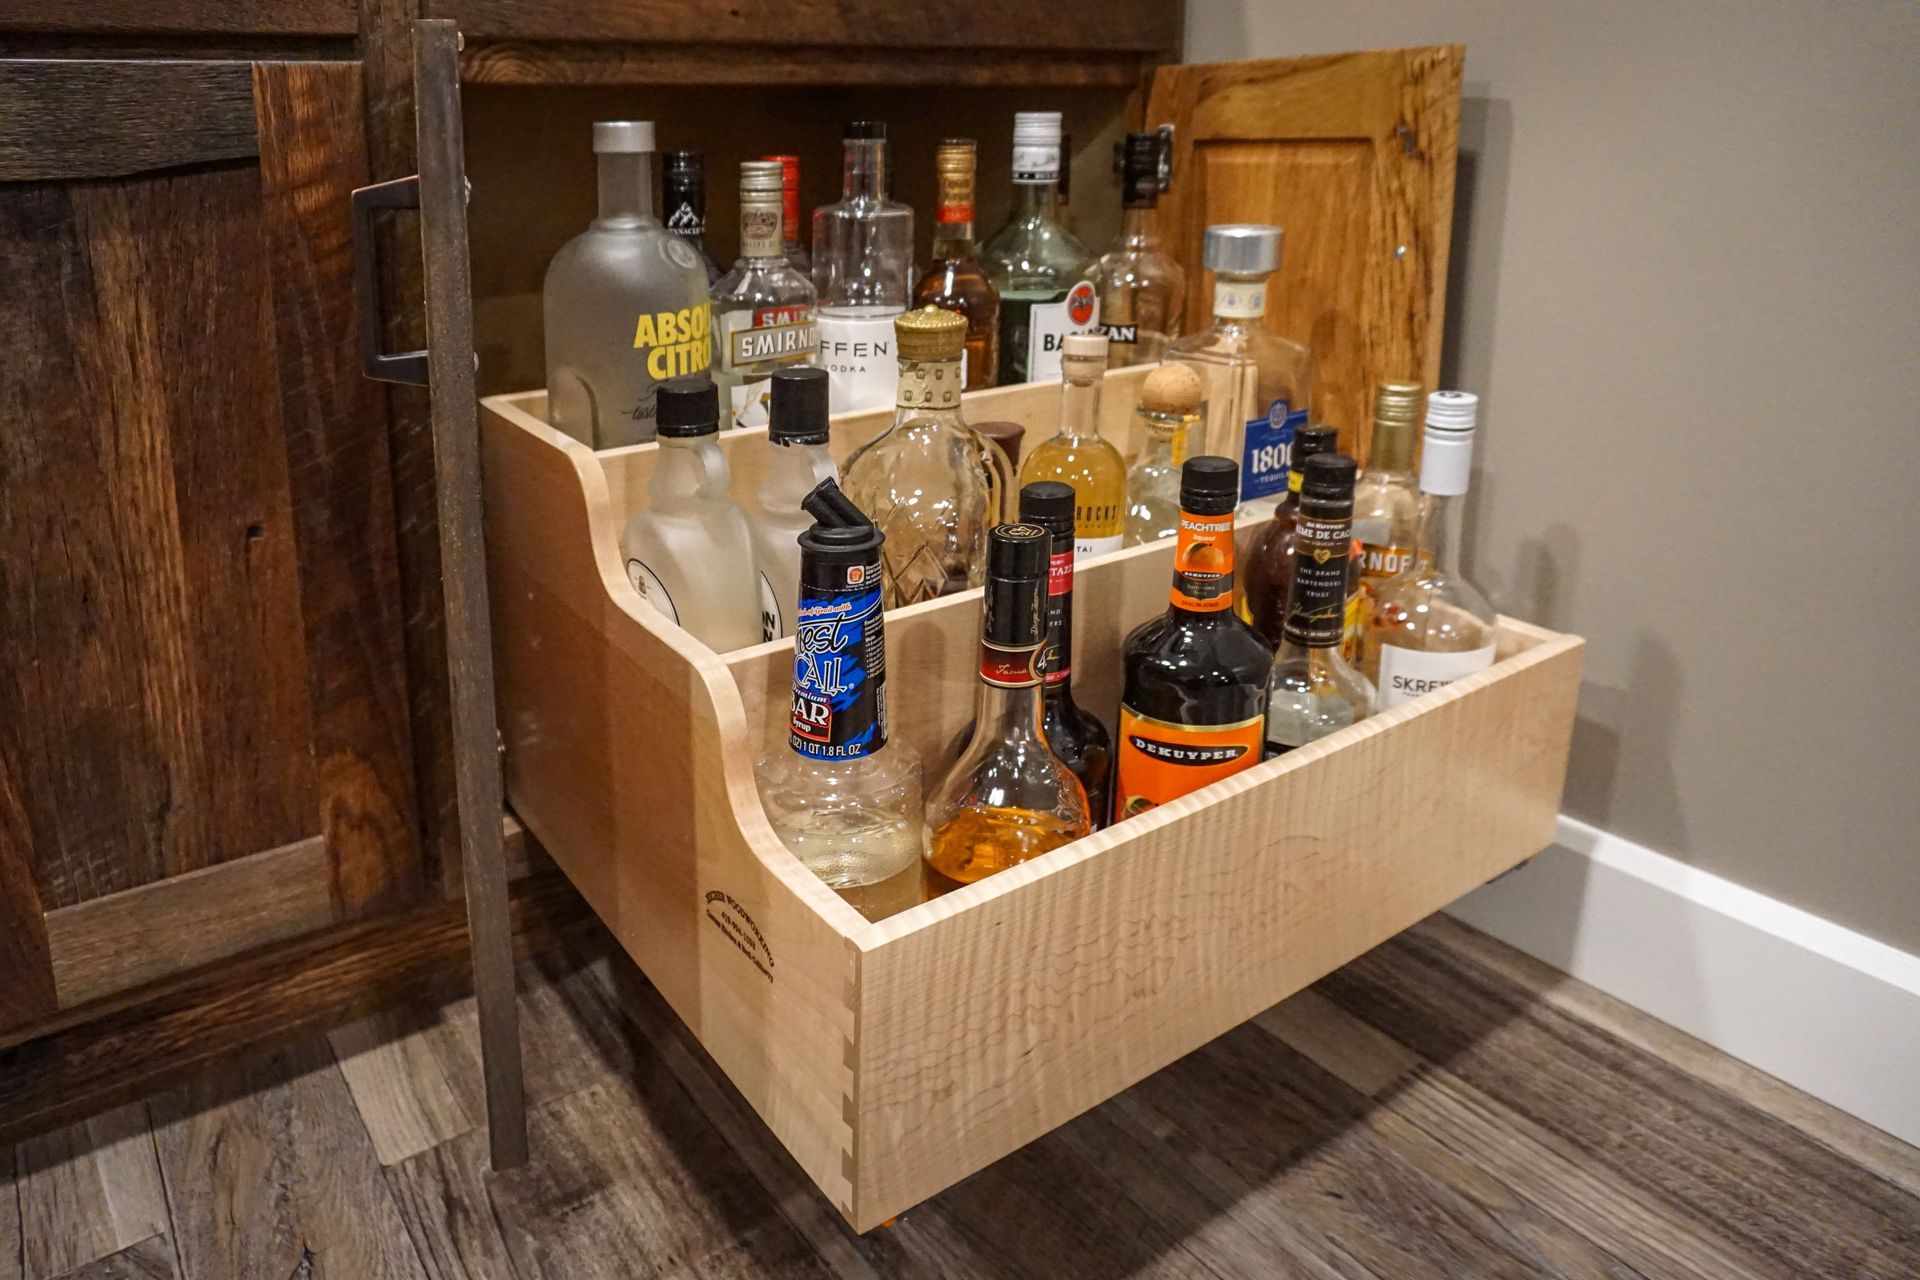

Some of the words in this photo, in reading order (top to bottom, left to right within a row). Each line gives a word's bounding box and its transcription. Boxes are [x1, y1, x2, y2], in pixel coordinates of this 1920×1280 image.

[1181, 519, 1232, 532] PEACHTREE
[808, 743, 821, 755] QT
[822, 745, 834, 757] 1.8
[836, 745, 847, 756] FL
[848, 743, 861, 755] OZ
[1135, 738, 1236, 761] DEKUYPER
